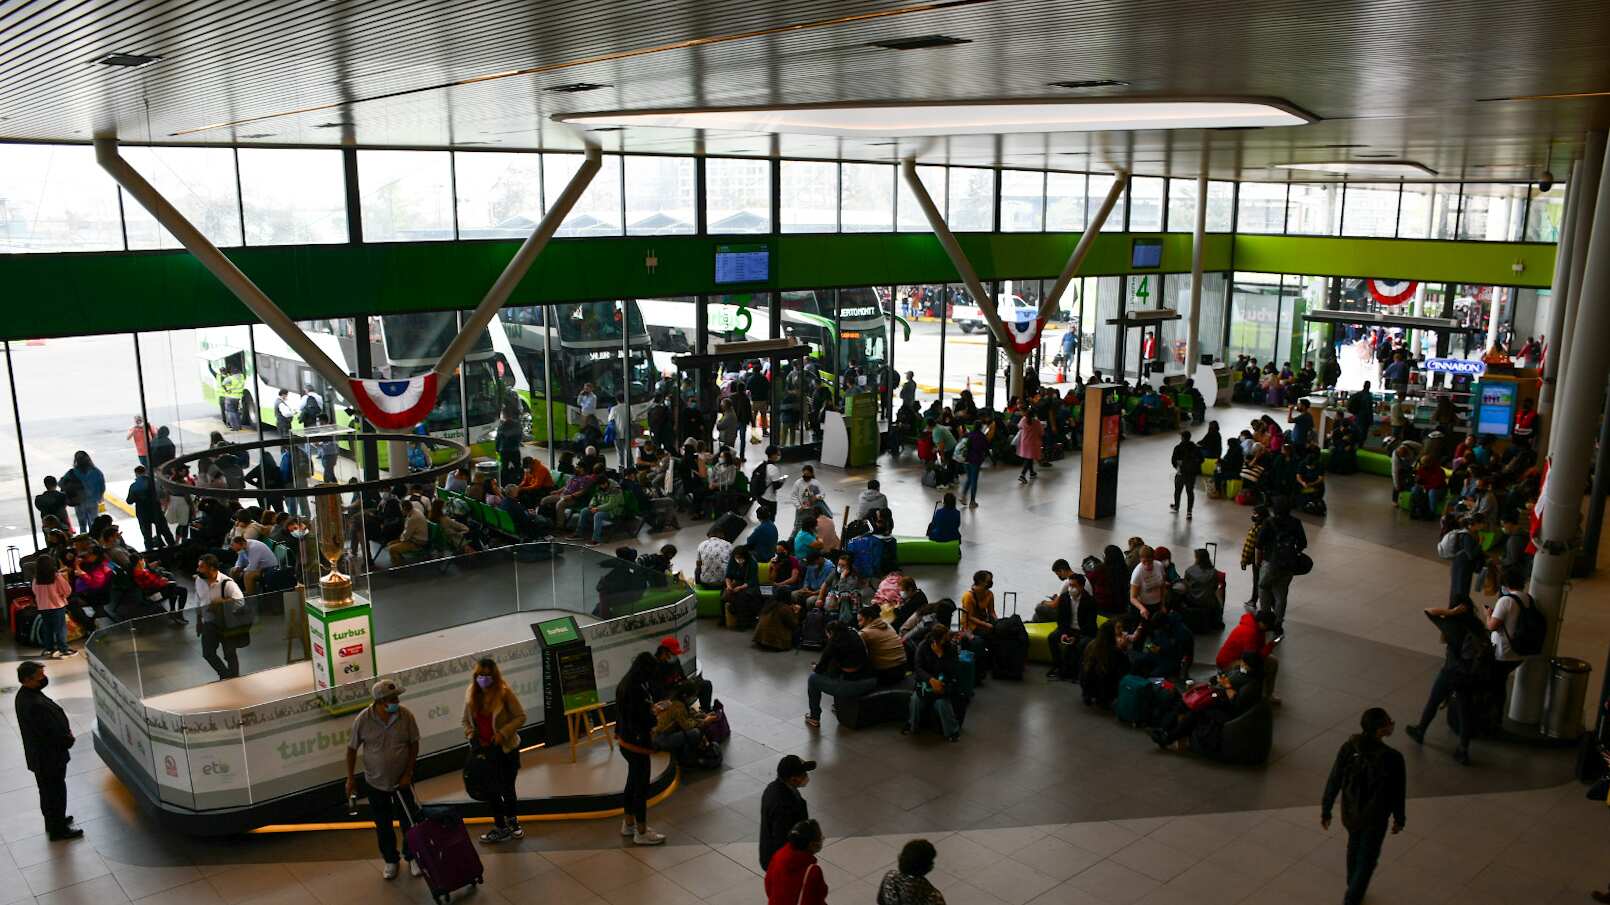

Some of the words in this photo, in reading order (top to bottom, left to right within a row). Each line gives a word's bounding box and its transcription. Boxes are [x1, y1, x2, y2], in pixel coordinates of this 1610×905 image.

[1136, 274, 1150, 305] 4
[1427, 361, 1481, 372] CINNABON
[332, 628, 366, 641] turbus
